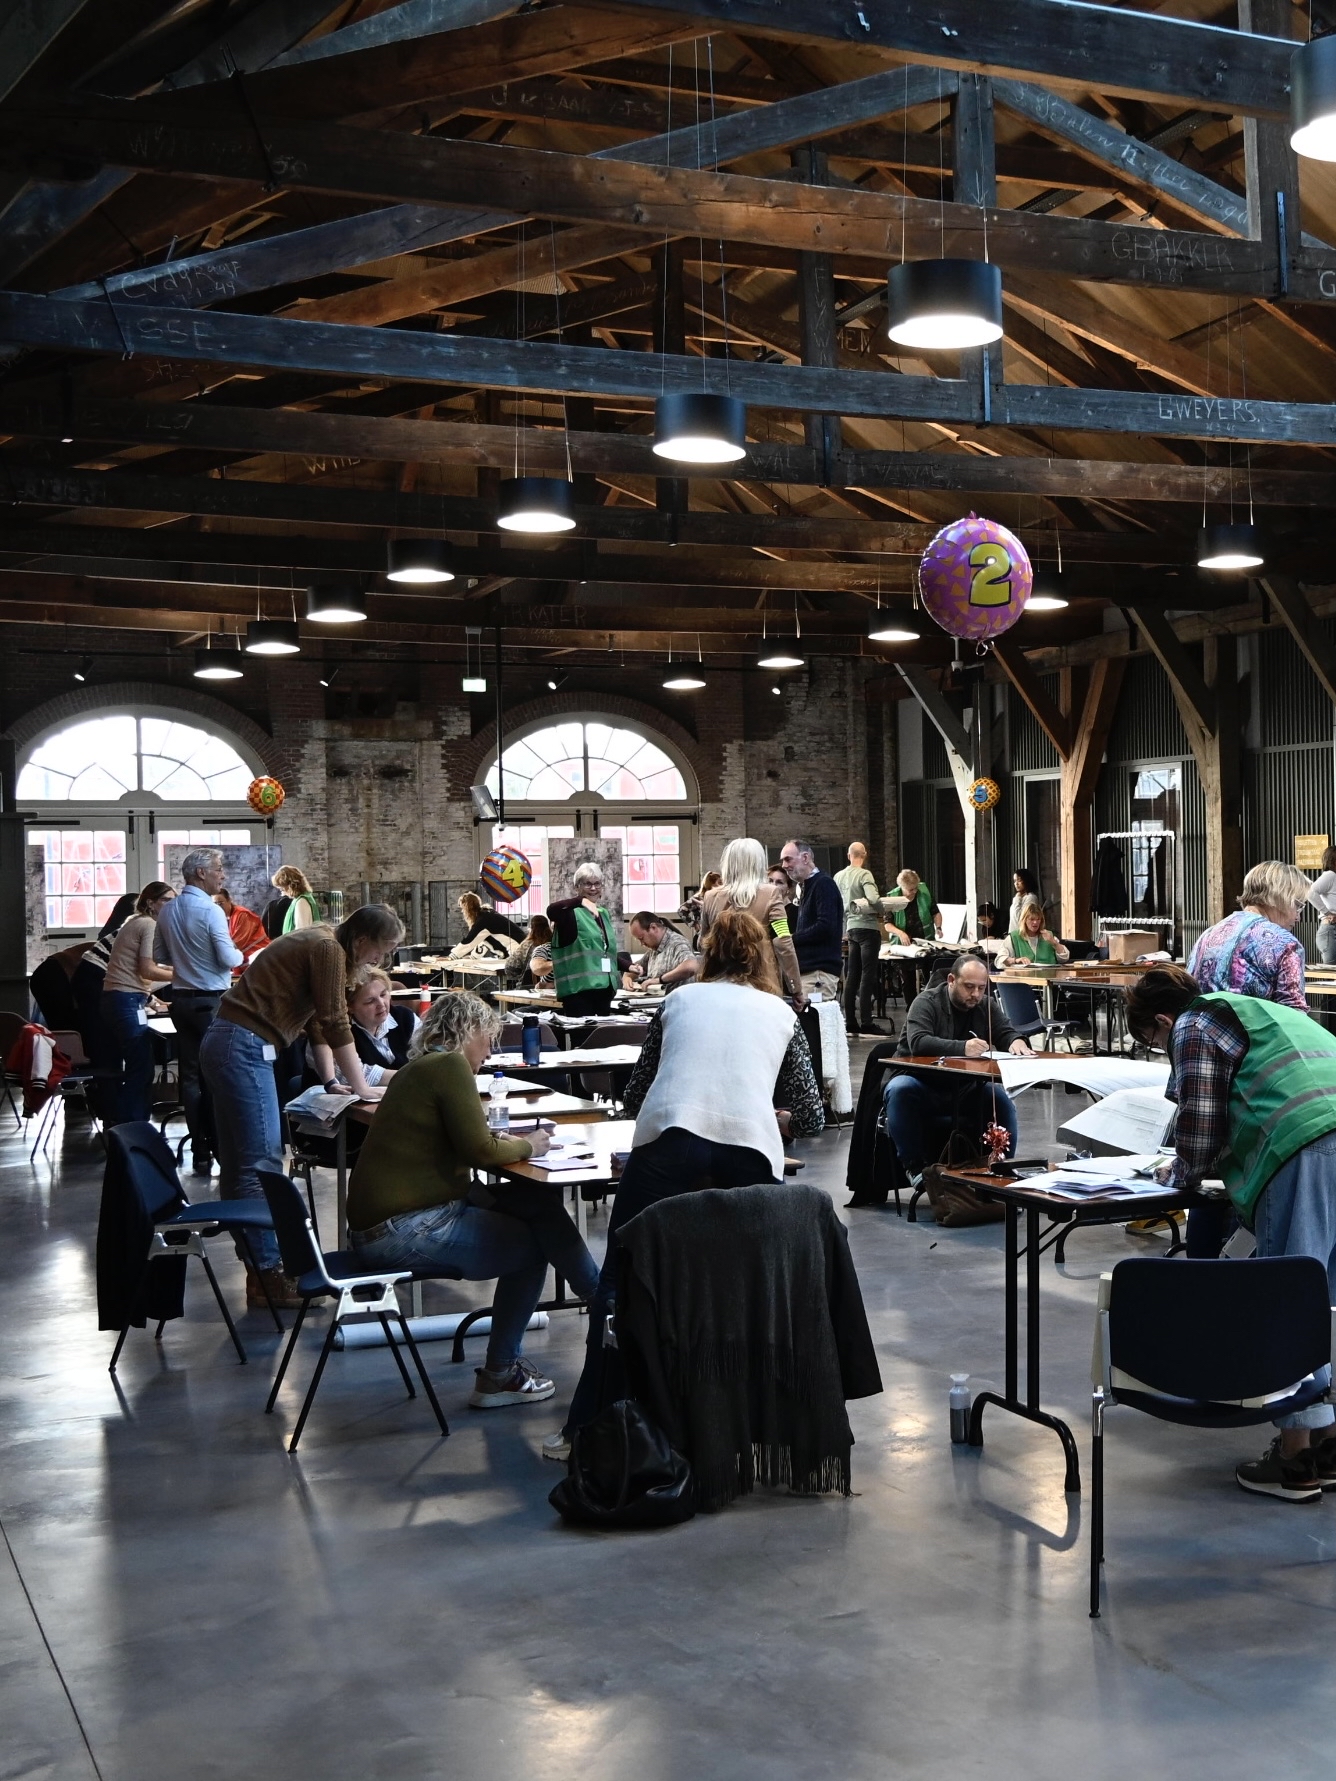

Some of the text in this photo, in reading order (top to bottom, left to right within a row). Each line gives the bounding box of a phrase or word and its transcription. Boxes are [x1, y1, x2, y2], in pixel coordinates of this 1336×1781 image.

[968, 542, 1012, 608] 2
[261, 785, 277, 807] 6
[502, 859, 524, 888] 4
